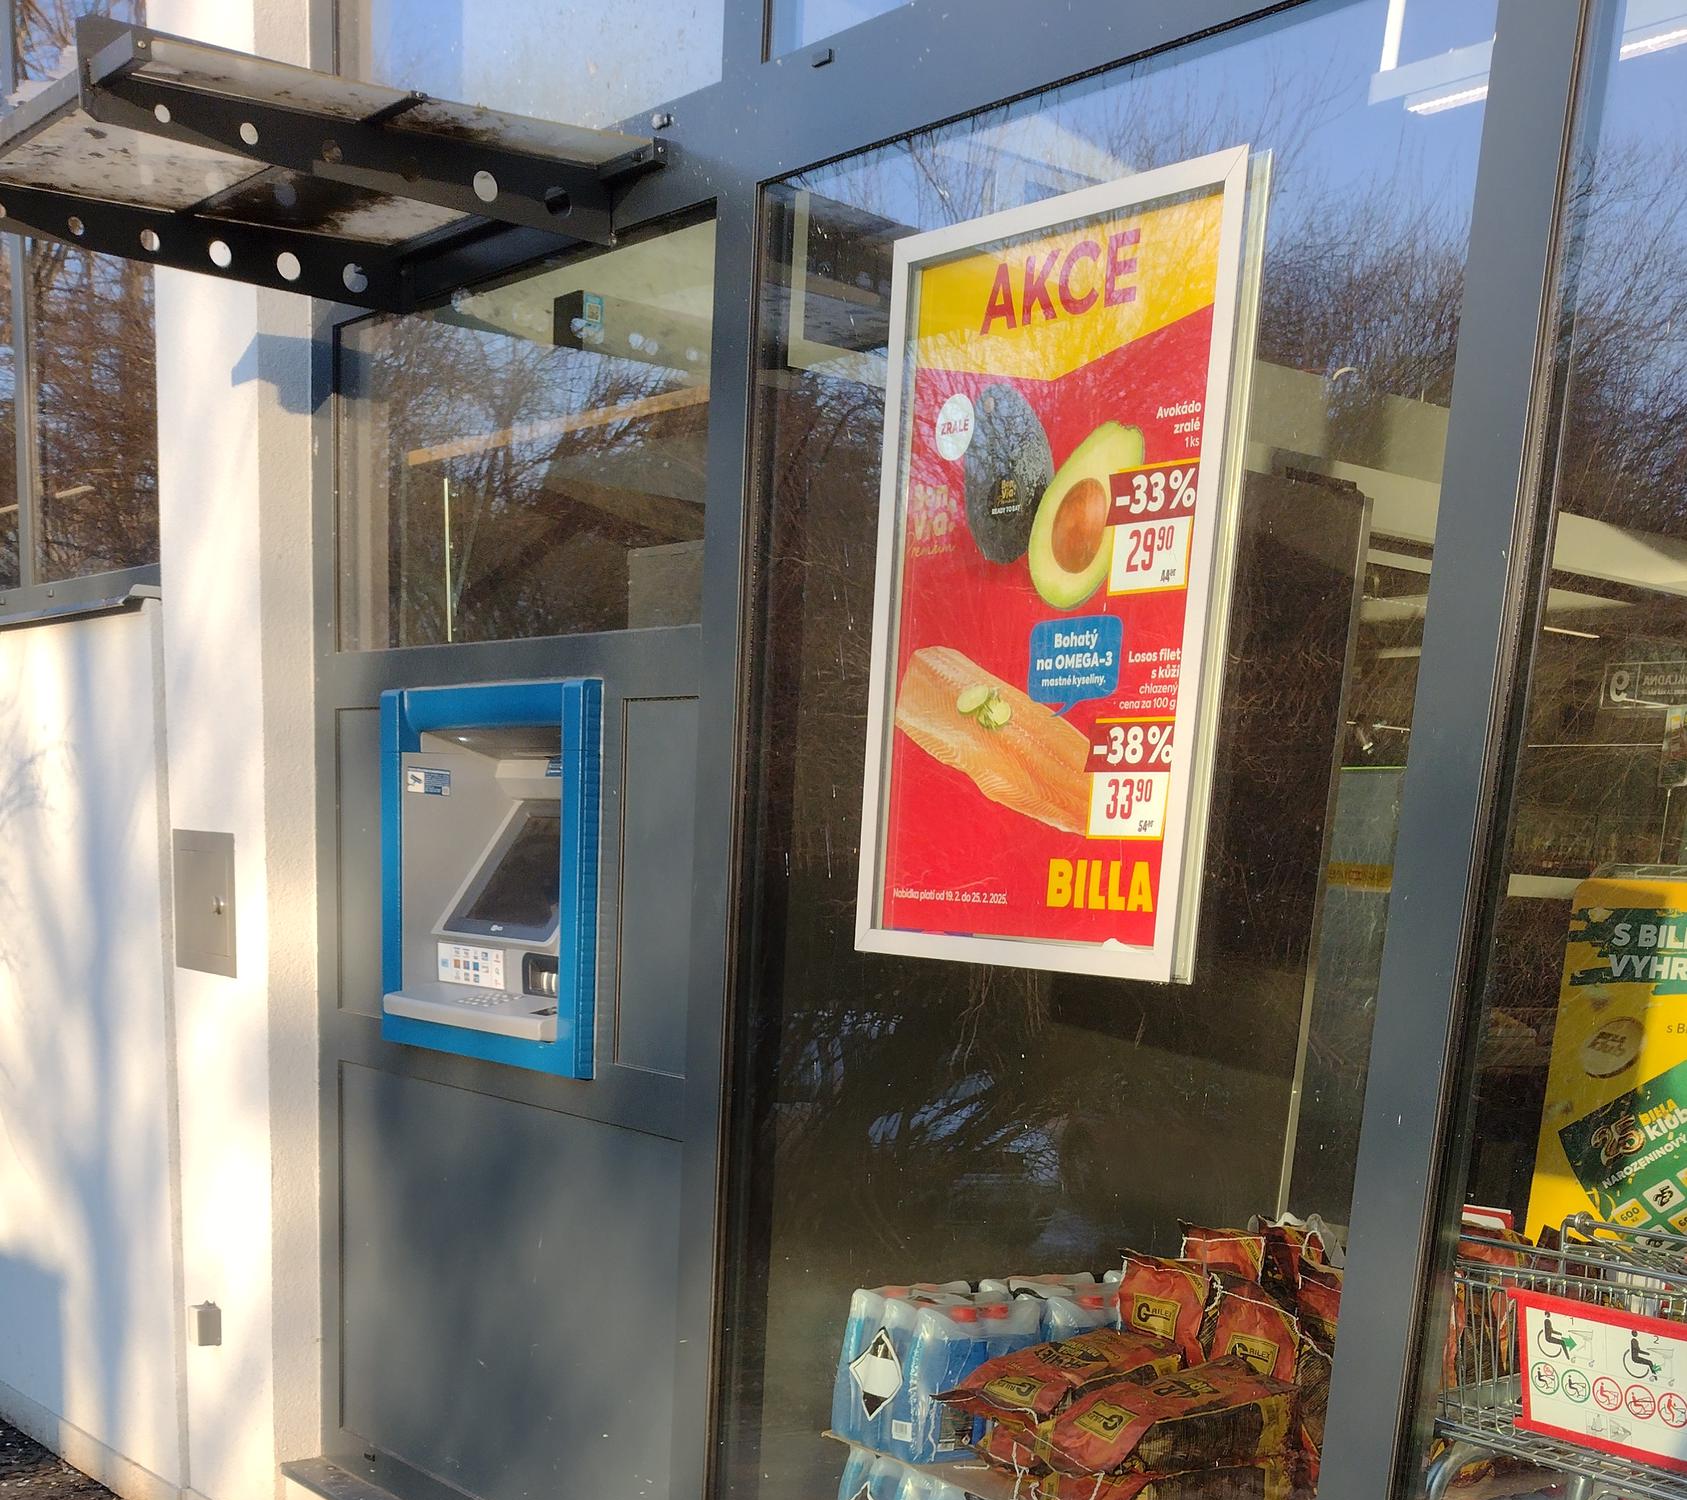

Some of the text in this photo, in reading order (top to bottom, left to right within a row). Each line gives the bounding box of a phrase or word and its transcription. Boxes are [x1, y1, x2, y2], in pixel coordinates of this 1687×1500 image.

[980, 228, 1141, 336] AKCE
[1156, 400, 1202, 419] Avokádo
[941, 418, 970, 436] ZRALÉ
[1173, 416, 1201, 434] zralé
[1115, 467, 1196, 515] -33%
[1053, 628, 1099, 650] Bohatý
[1036, 651, 1113, 671] na OMEGA-3
[1128, 647, 1182, 663] Losos filet
[1041, 675, 1072, 687] mastné
[1151, 669, 1157, 679] s
[1139, 680, 1178, 696] chlazený
[1119, 697, 1177, 711] cena za 100 g
[1093, 725, 1174, 764] -38%
[1046, 858, 1154, 912] BILLA
[893, 887, 919, 900] Nabídka
[920, 888, 935, 901] platí
[936, 889, 944, 901] od
[945, 890, 954, 902] 19.
[954, 891, 961, 902] 2.
[961, 891, 972, 903] do
[972, 892, 981, 903] 25.
[982, 892, 989, 904] 2.
[1611, 922, 1632, 947] S
[1608, 954, 1687, 981] VYHR
[1666, 1022, 1687, 1034] s B
[1590, 1114, 1647, 1169] 25
[1620, 1206, 1640, 1222] 600
[1653, 1335, 1660, 1345] 2
[1231, 1342, 1271, 1363] GRILEX
